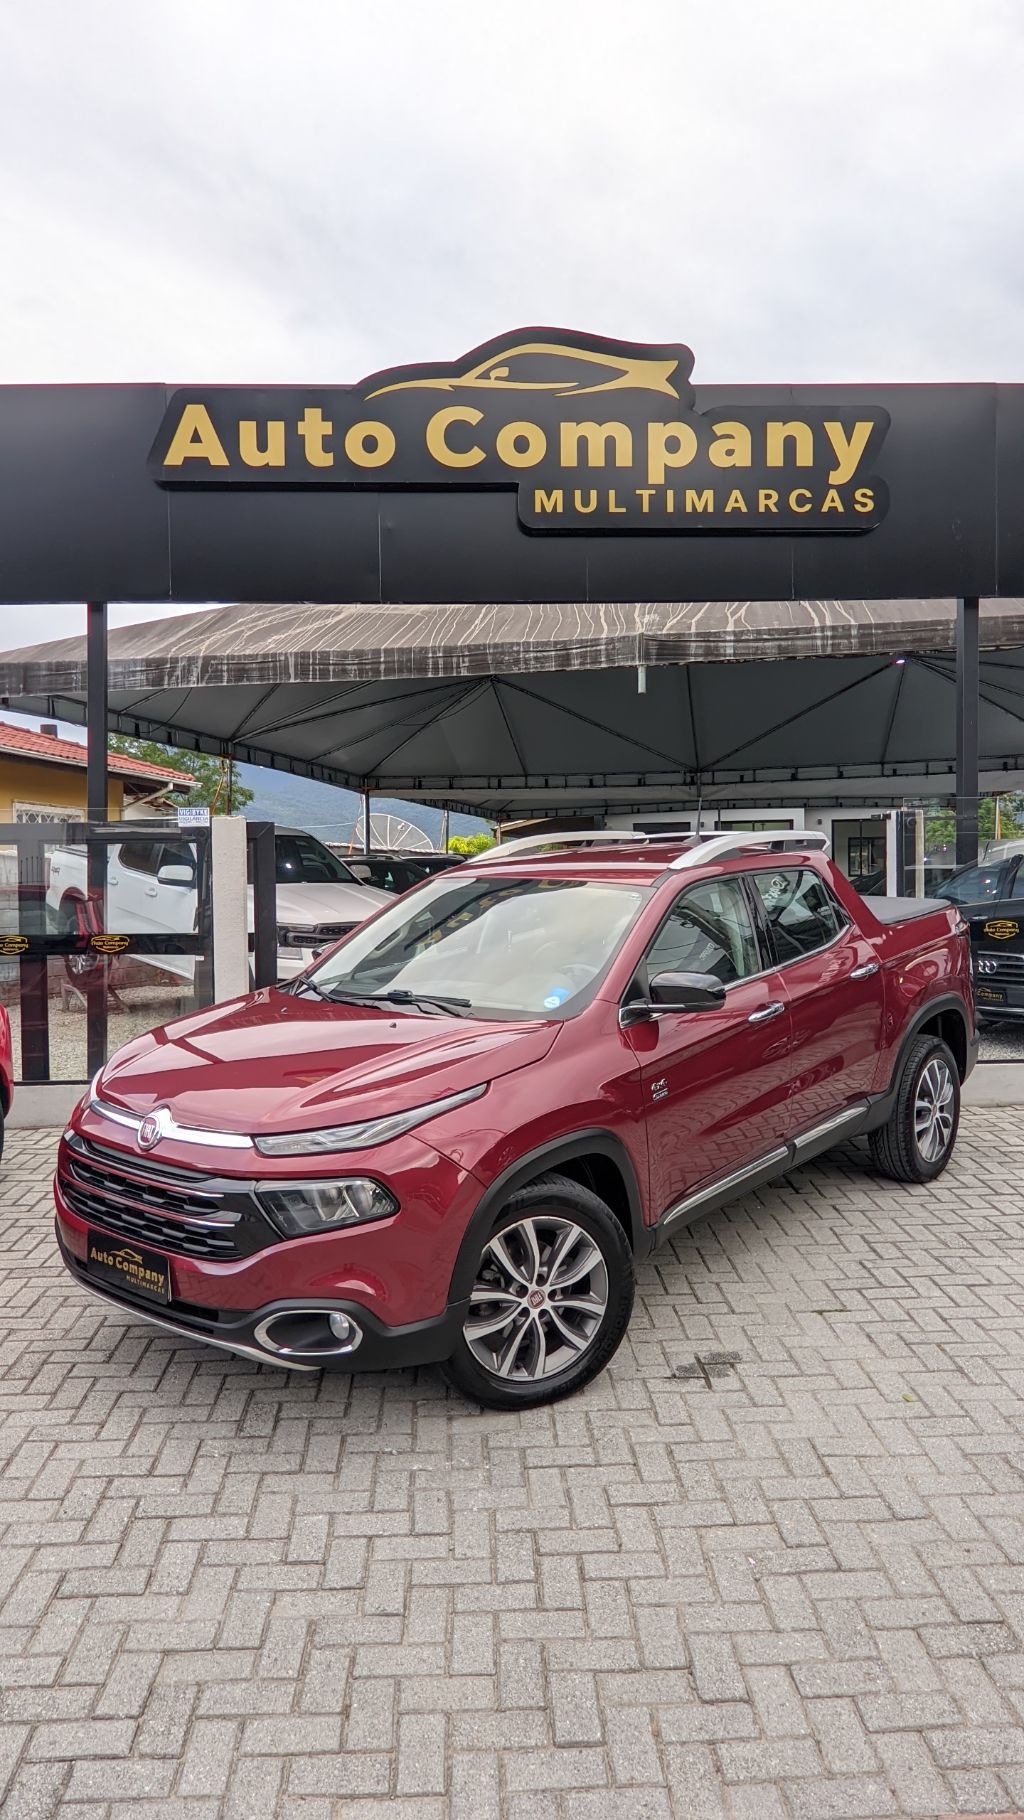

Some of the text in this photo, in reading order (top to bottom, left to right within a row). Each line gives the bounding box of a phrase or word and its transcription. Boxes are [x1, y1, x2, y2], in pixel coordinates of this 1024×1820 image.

[163, 404, 874, 487] Auto Company
[534, 488, 875, 514] MULTIMARCAS
[90, 1247, 165, 1287] Auto Company
